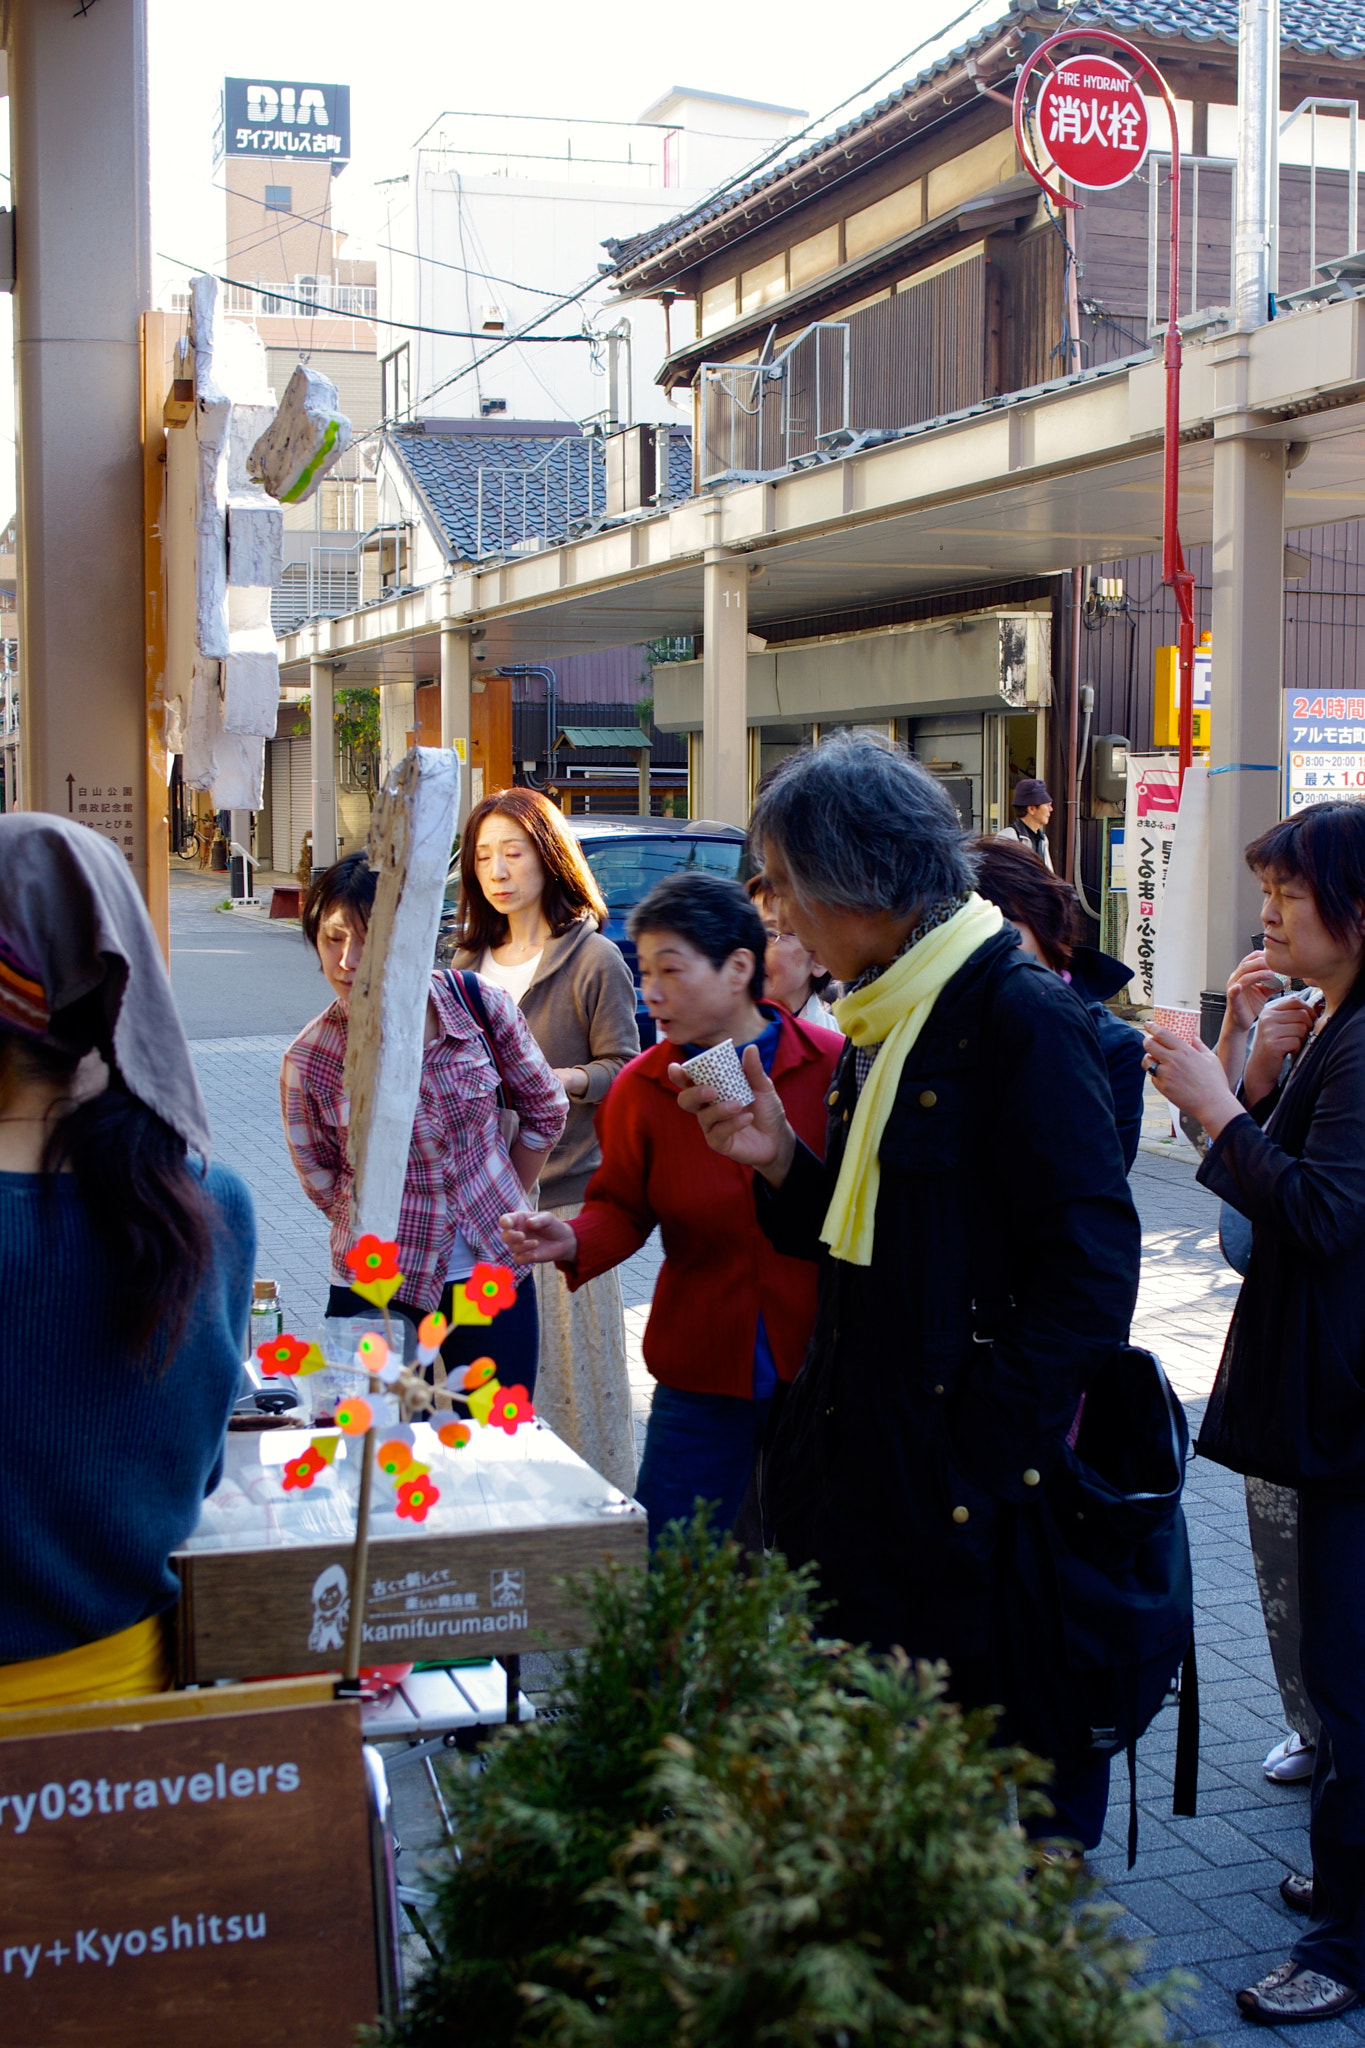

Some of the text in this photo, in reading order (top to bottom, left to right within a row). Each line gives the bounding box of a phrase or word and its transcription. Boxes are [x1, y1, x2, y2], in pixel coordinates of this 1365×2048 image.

[1057, 71, 1131, 93] FIRE HYDRANT
[247, 85, 329, 126] DIA
[1049, 93, 1141, 151] 消火栓
[722, 590, 740, 608] 11
[79, 787, 133, 796] 白山公園
[79, 803, 133, 813] 県政記念館
[361, 1608, 529, 1643] kamifurumachi
[0, 1761, 301, 1834] ry03travelers
[3, 1912, 267, 1978] ry+Kyoshitsu
